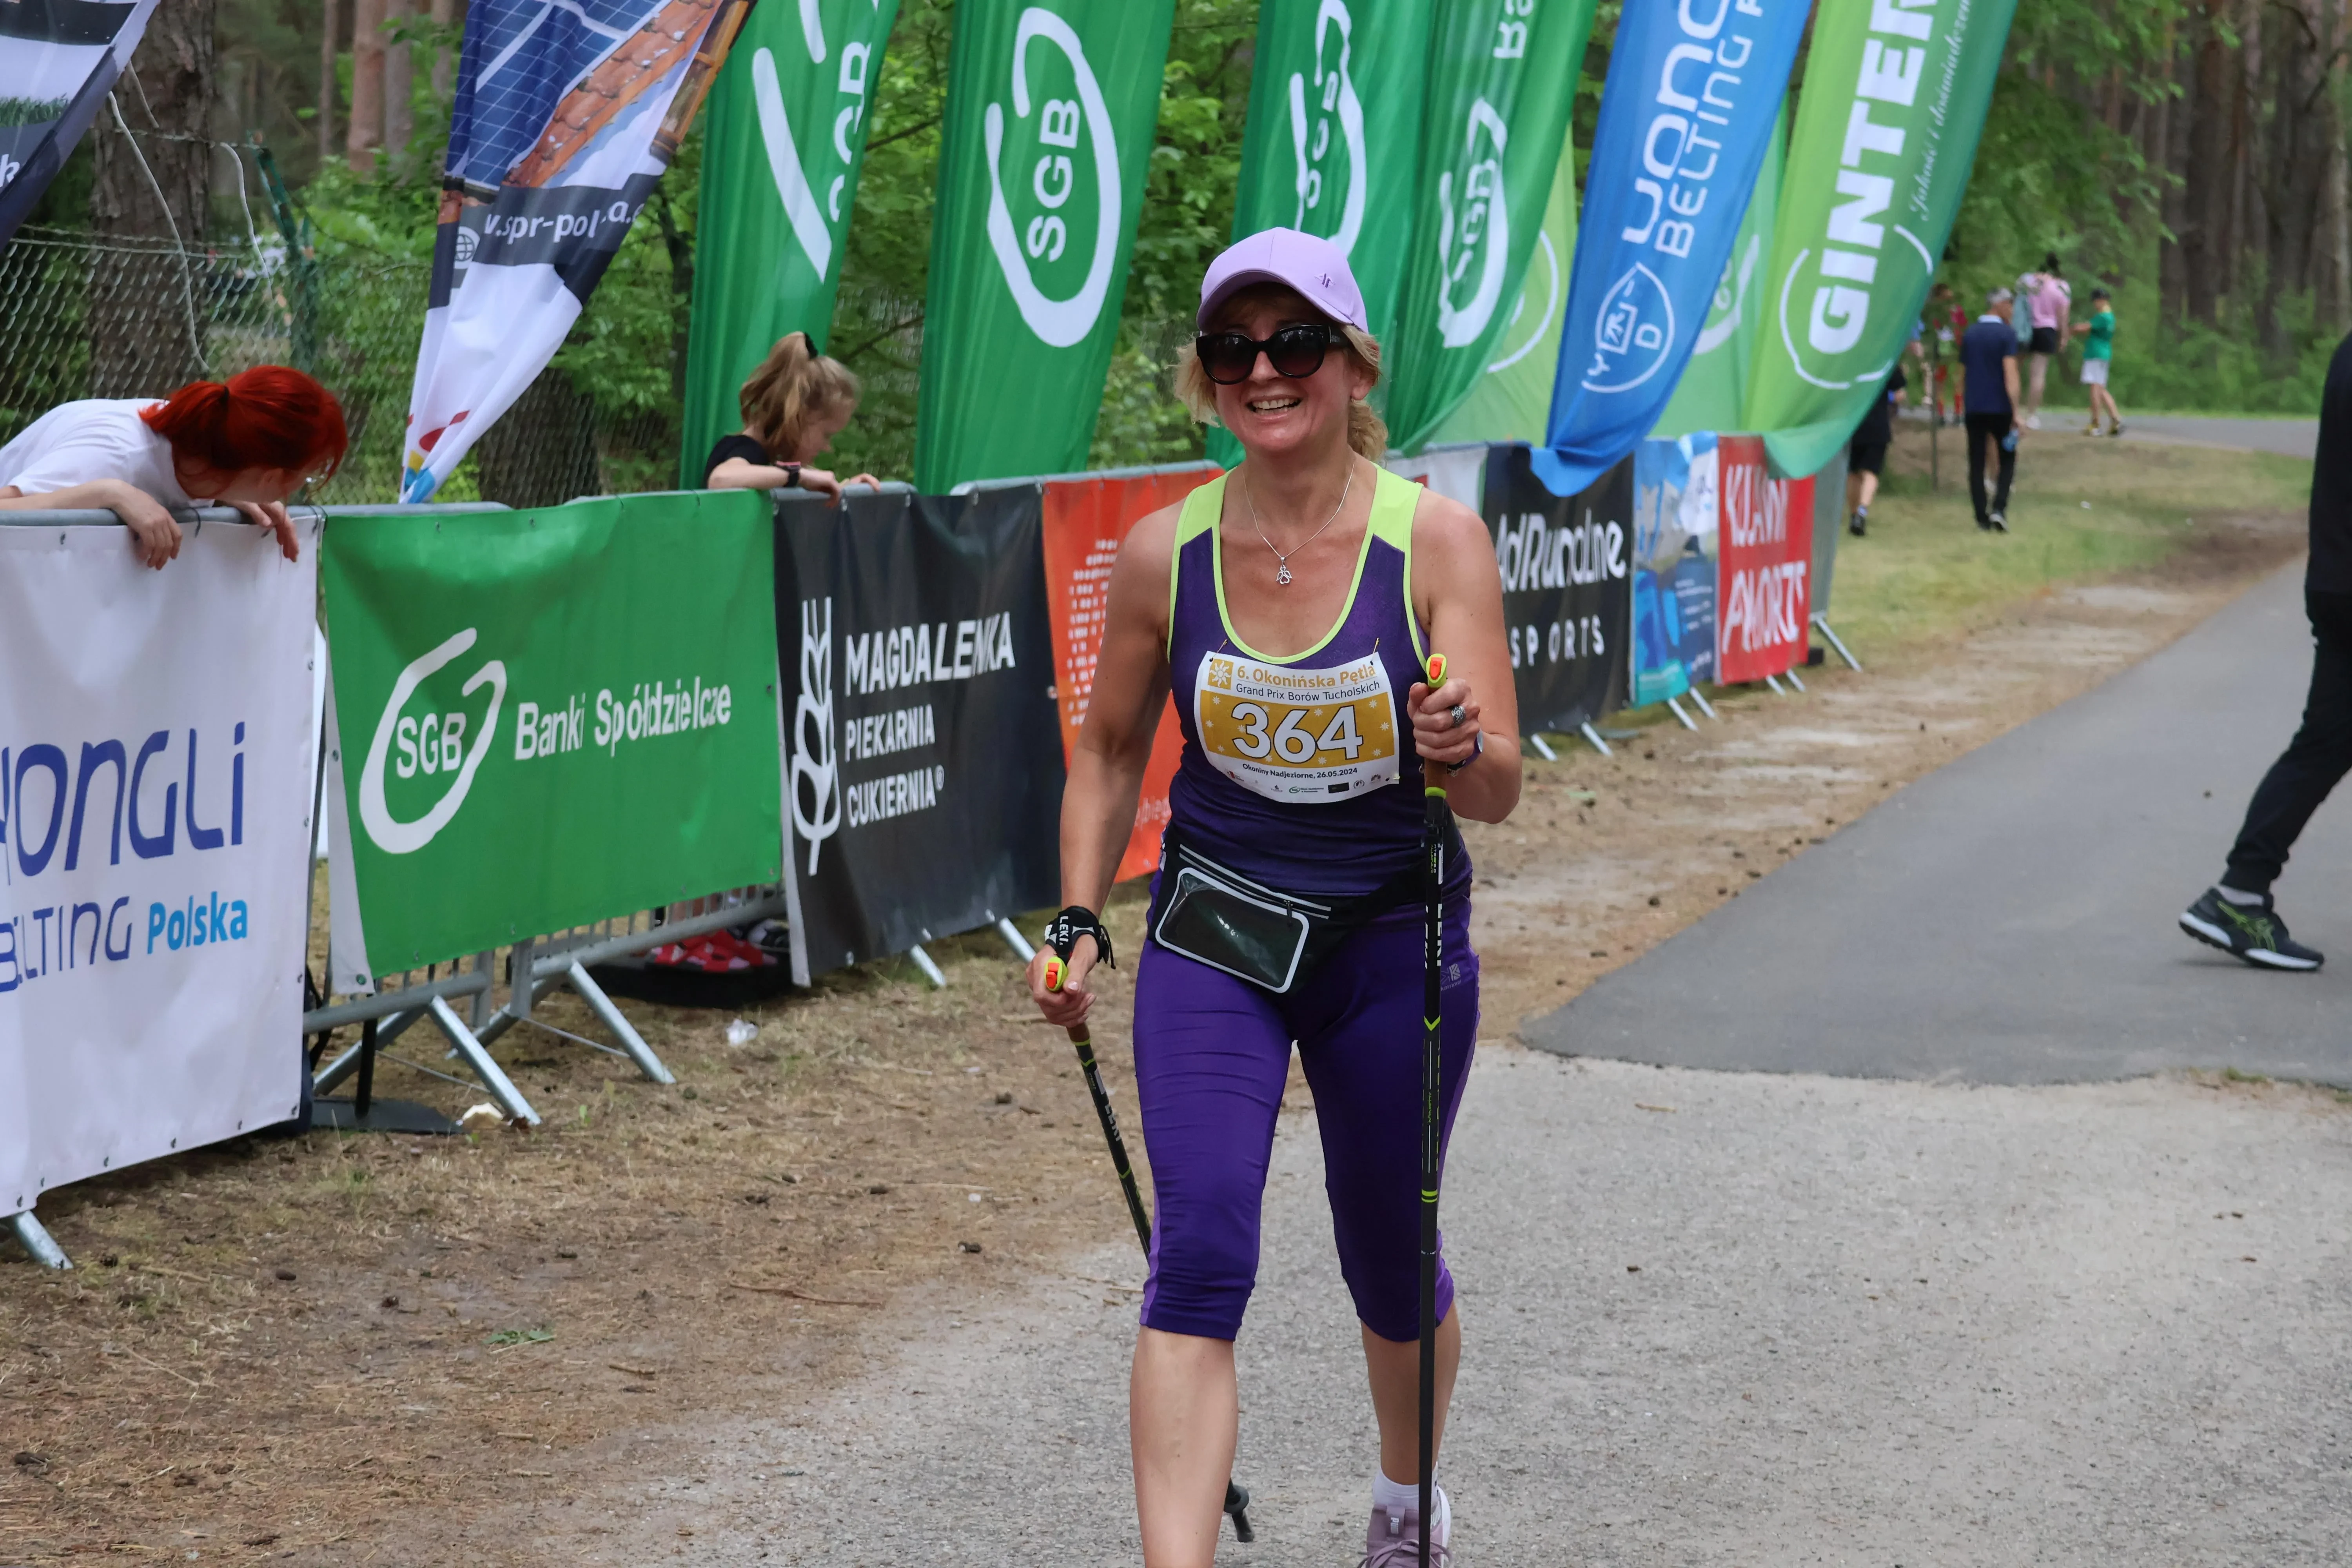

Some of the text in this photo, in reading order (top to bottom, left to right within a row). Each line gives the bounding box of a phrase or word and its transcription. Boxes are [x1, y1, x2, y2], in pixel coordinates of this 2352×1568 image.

[1026, 98, 1080, 262] SGB
[1510, 614, 1604, 669] SPORTS
[1236, 681, 1380, 701] Grand Prix Borów Tucholskich
[1237, 665, 1376, 688] 6. Okonińska Pętla
[396, 712, 467, 779] SGB
[515, 676, 731, 760] Banki Spółdzielcze
[845, 704, 936, 762] PIEKARNIA
[1231, 702, 1364, 764] 364
[1242, 763, 1358, 779] Okoniny Nadjeziorne, 26.05.2024
[147, 891, 248, 955] Polska
[1059, 916, 1069, 942] LEKI
